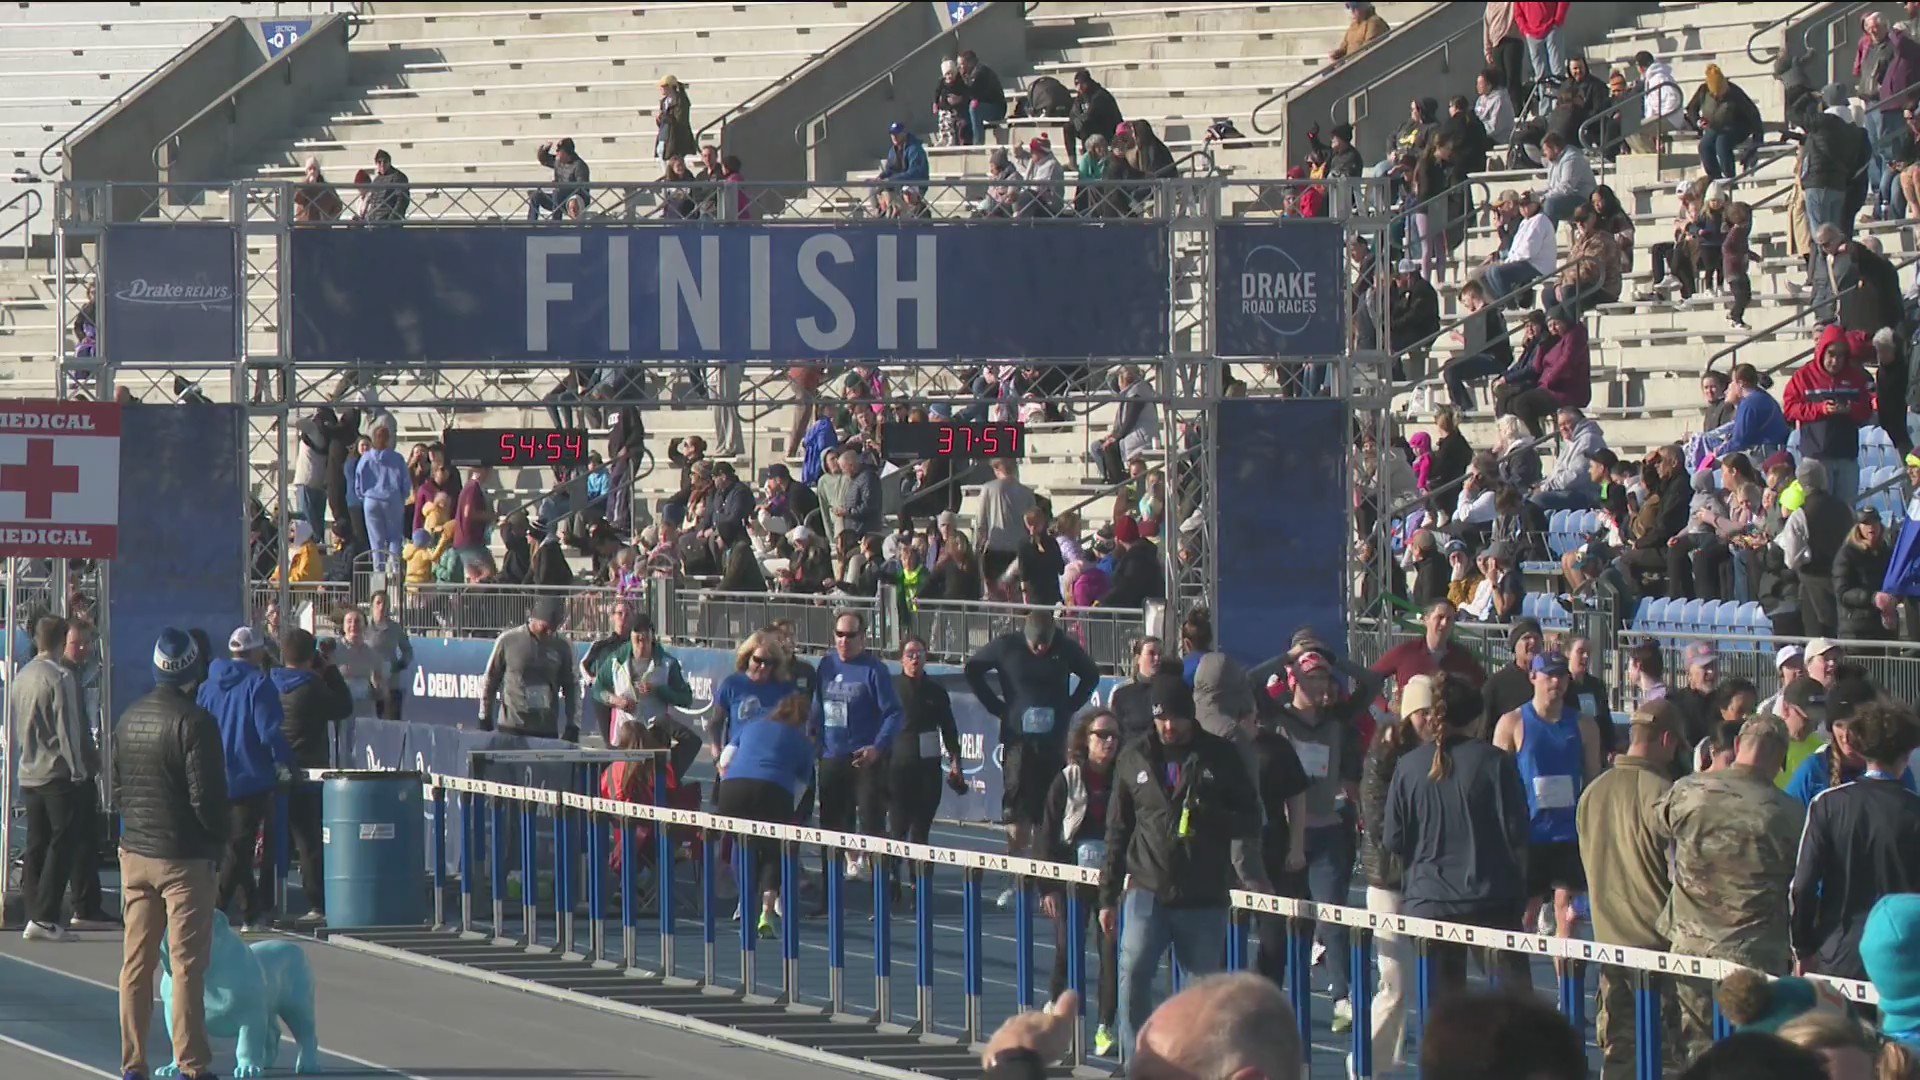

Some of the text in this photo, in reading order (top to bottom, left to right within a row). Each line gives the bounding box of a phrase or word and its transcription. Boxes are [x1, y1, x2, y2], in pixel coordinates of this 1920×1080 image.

[274, 32, 284, 48] Q
[128, 279, 229, 299] Drake RELAYS
[526, 233, 937, 351] FINISH
[1241, 271, 1317, 299] DRAKE
[1242, 299, 1317, 314] ROAD RACES
[0, 528, 92, 545] EDICAL
[428, 673, 459, 698] DELTA
